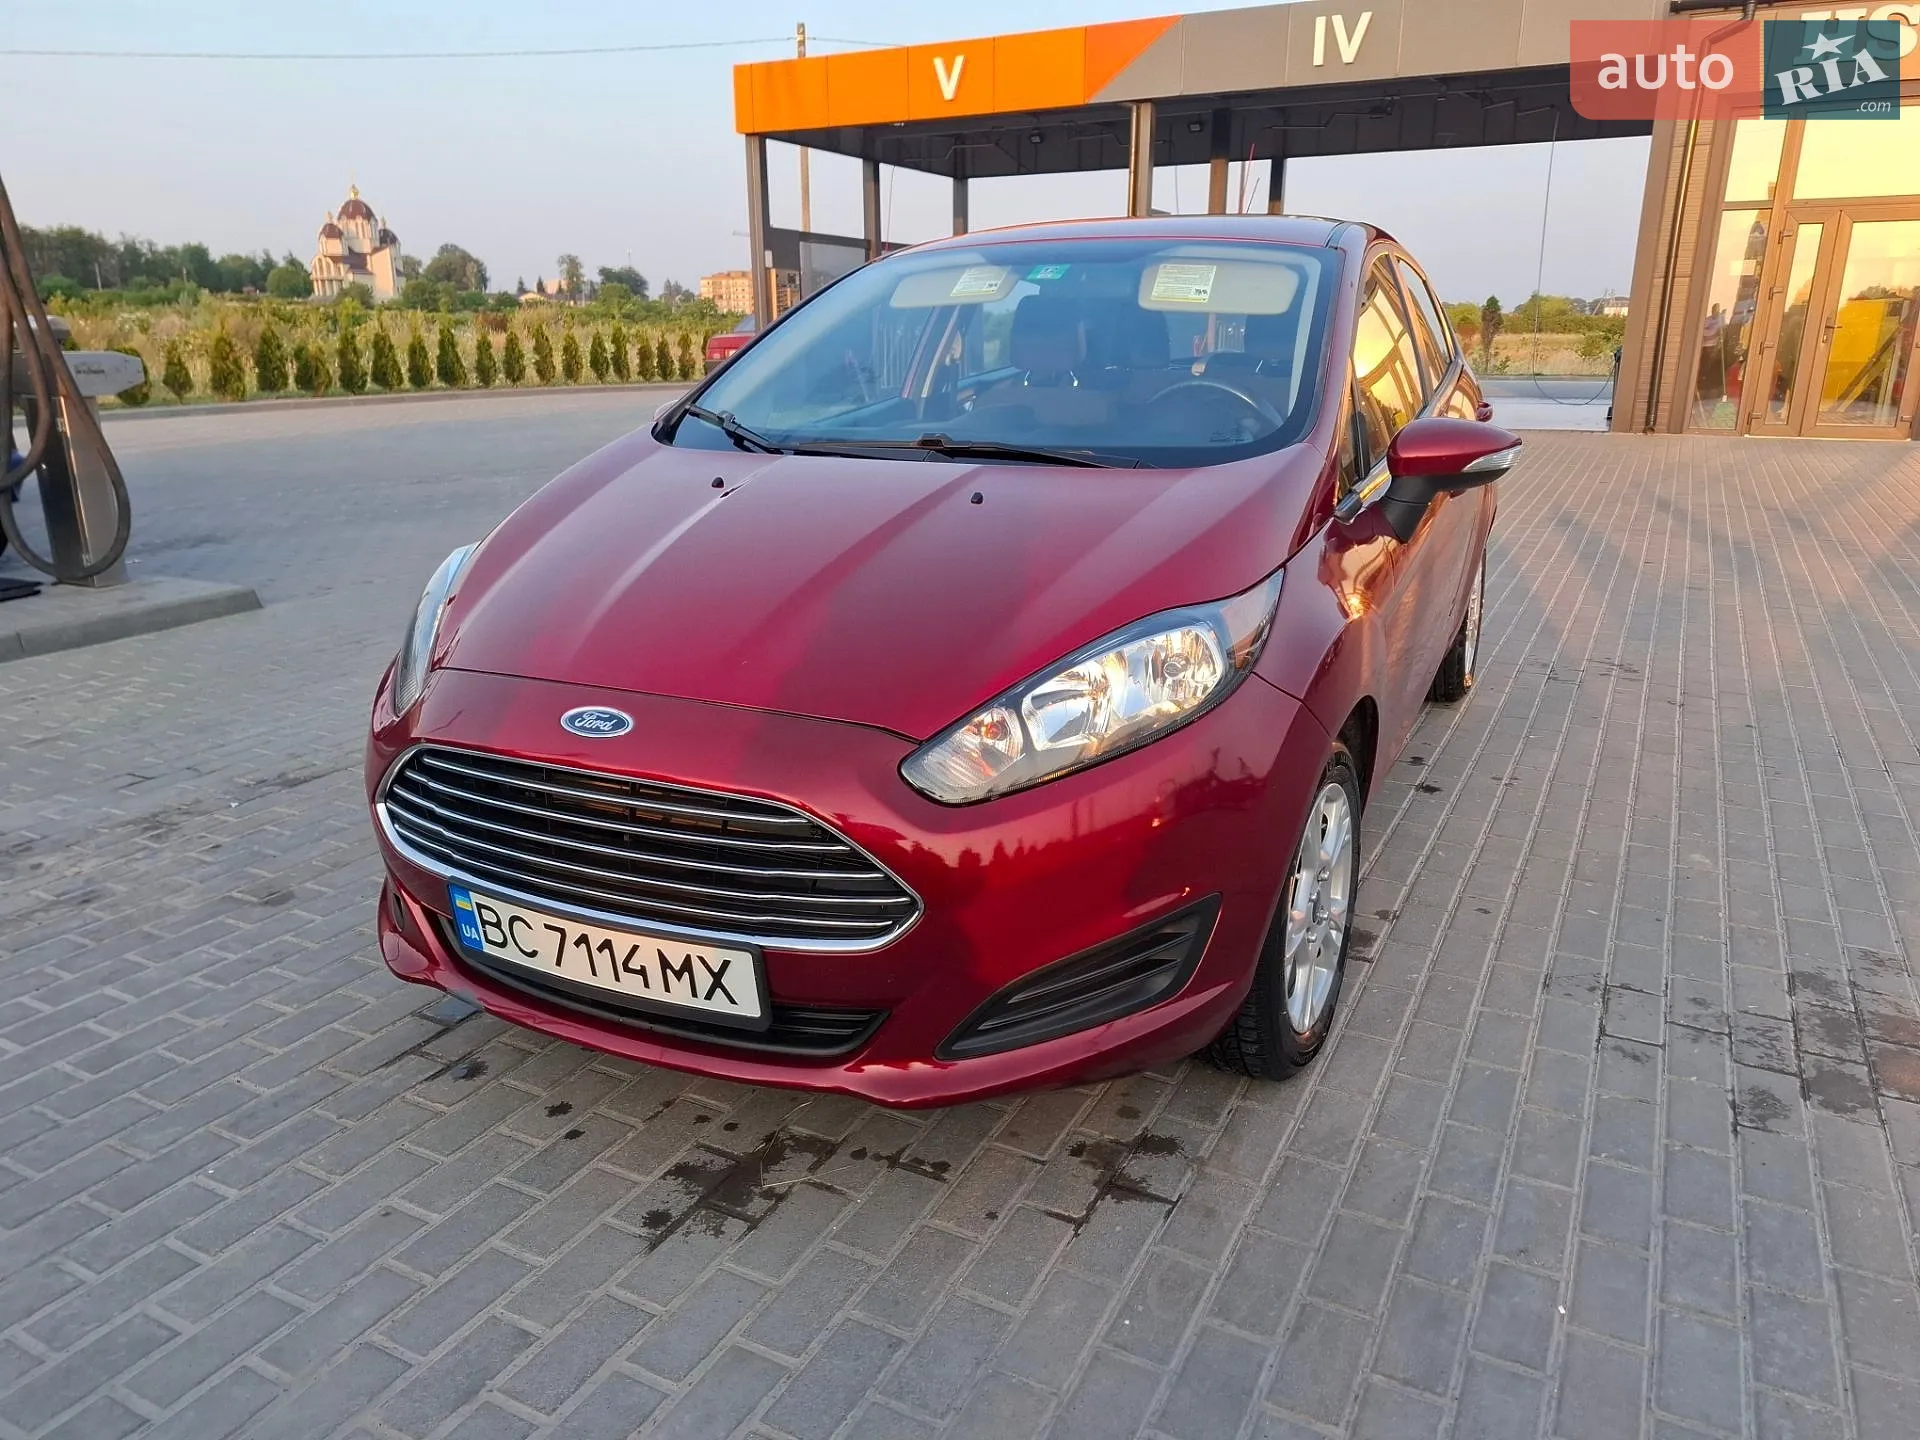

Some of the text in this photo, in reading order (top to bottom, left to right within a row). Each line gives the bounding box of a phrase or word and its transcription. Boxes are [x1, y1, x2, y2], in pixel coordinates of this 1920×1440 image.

[1312, 11, 1373, 66] IV
[933, 55, 965, 102] V
[574, 711, 618, 731] Ford
[462, 923, 480, 941] UA
